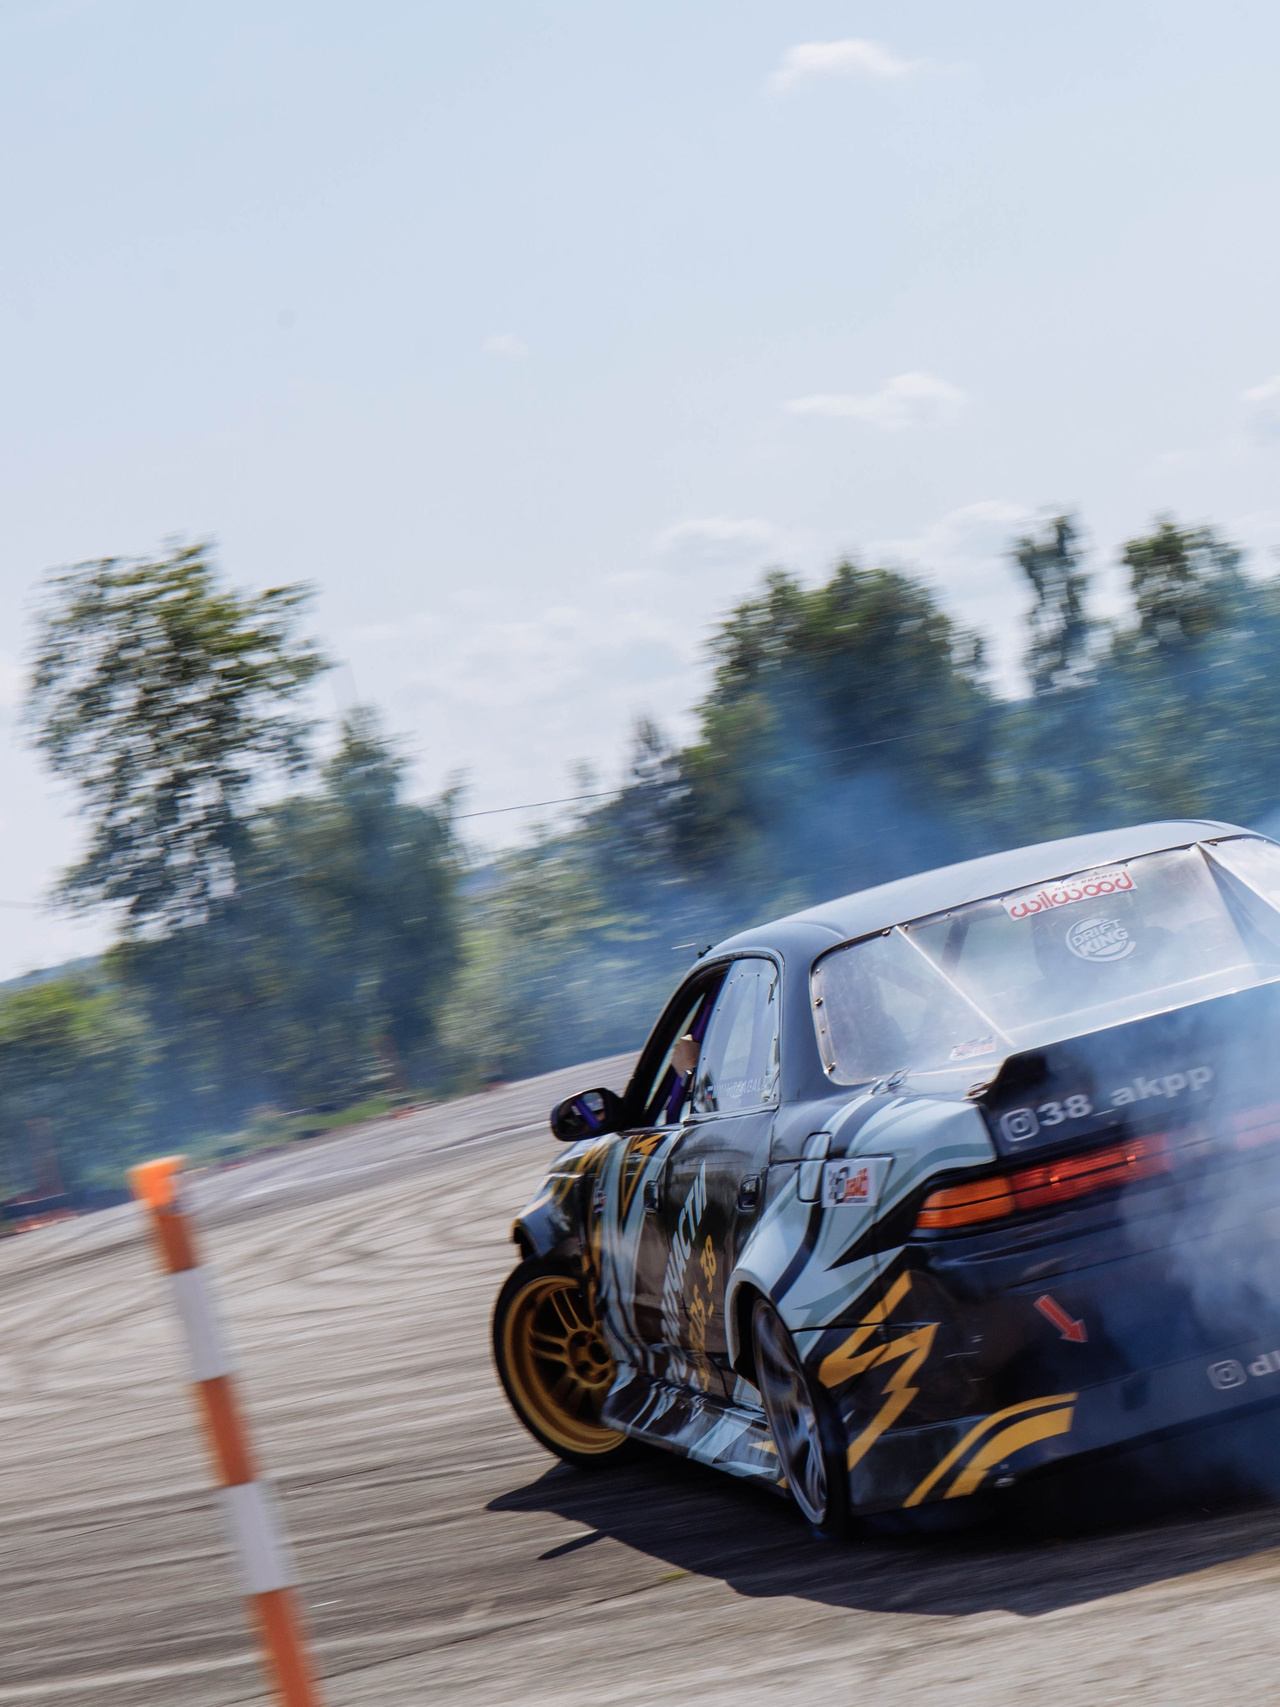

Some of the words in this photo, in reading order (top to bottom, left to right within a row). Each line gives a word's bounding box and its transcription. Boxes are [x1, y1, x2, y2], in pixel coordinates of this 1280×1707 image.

[1010, 871, 1133, 918] wilwood
[1071, 919, 1121, 947] DRIFT
[1078, 928, 1130, 957] KING
[1037, 1066, 1214, 1127] 38_akpp
